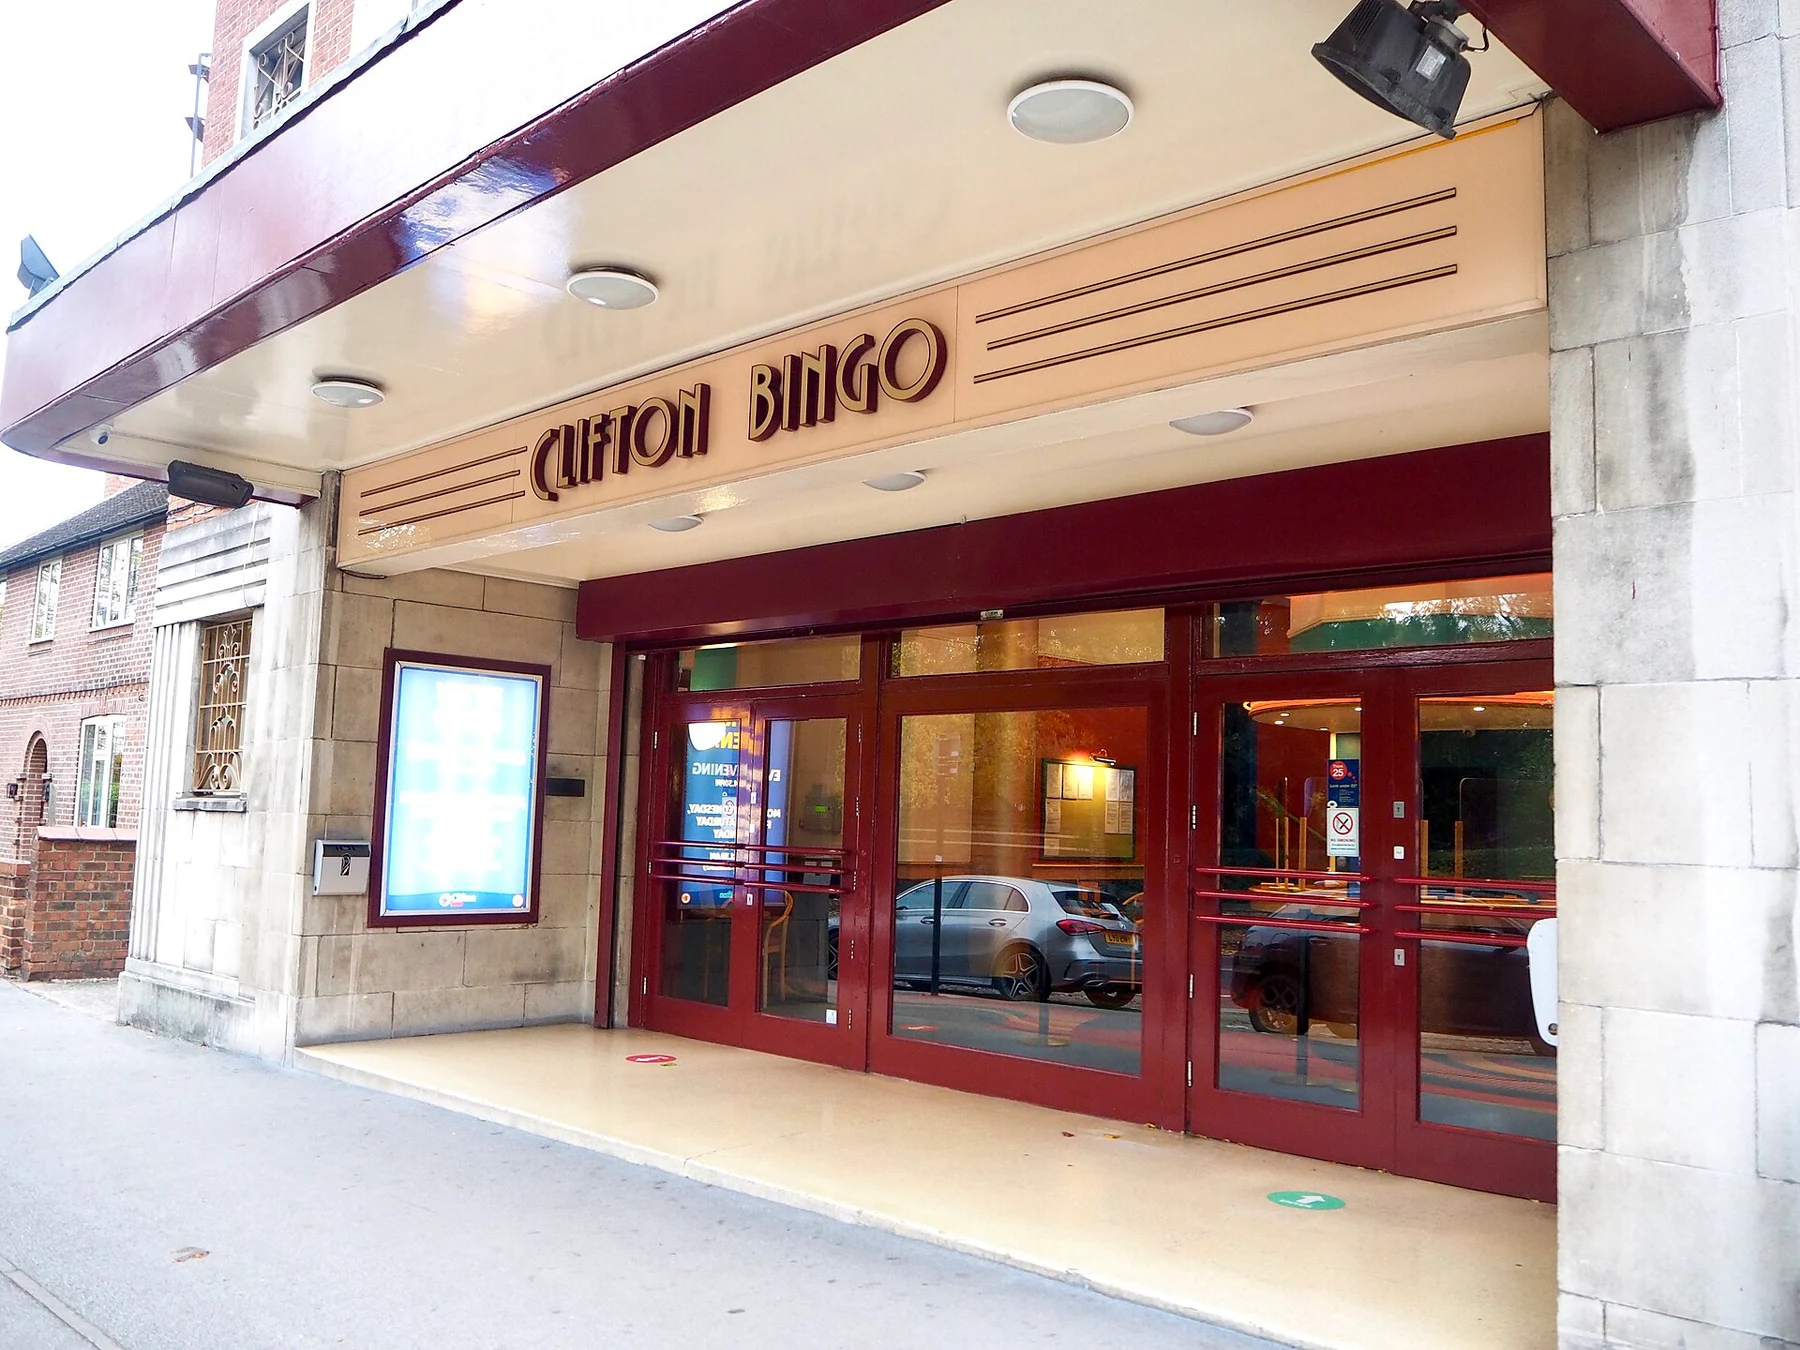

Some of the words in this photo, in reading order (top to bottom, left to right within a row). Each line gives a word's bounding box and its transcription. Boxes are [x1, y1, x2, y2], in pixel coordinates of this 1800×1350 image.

[530, 382, 711, 502] CLIFTON
[748, 317, 948, 443] BINGO
[1333, 769, 1344, 777] 25
